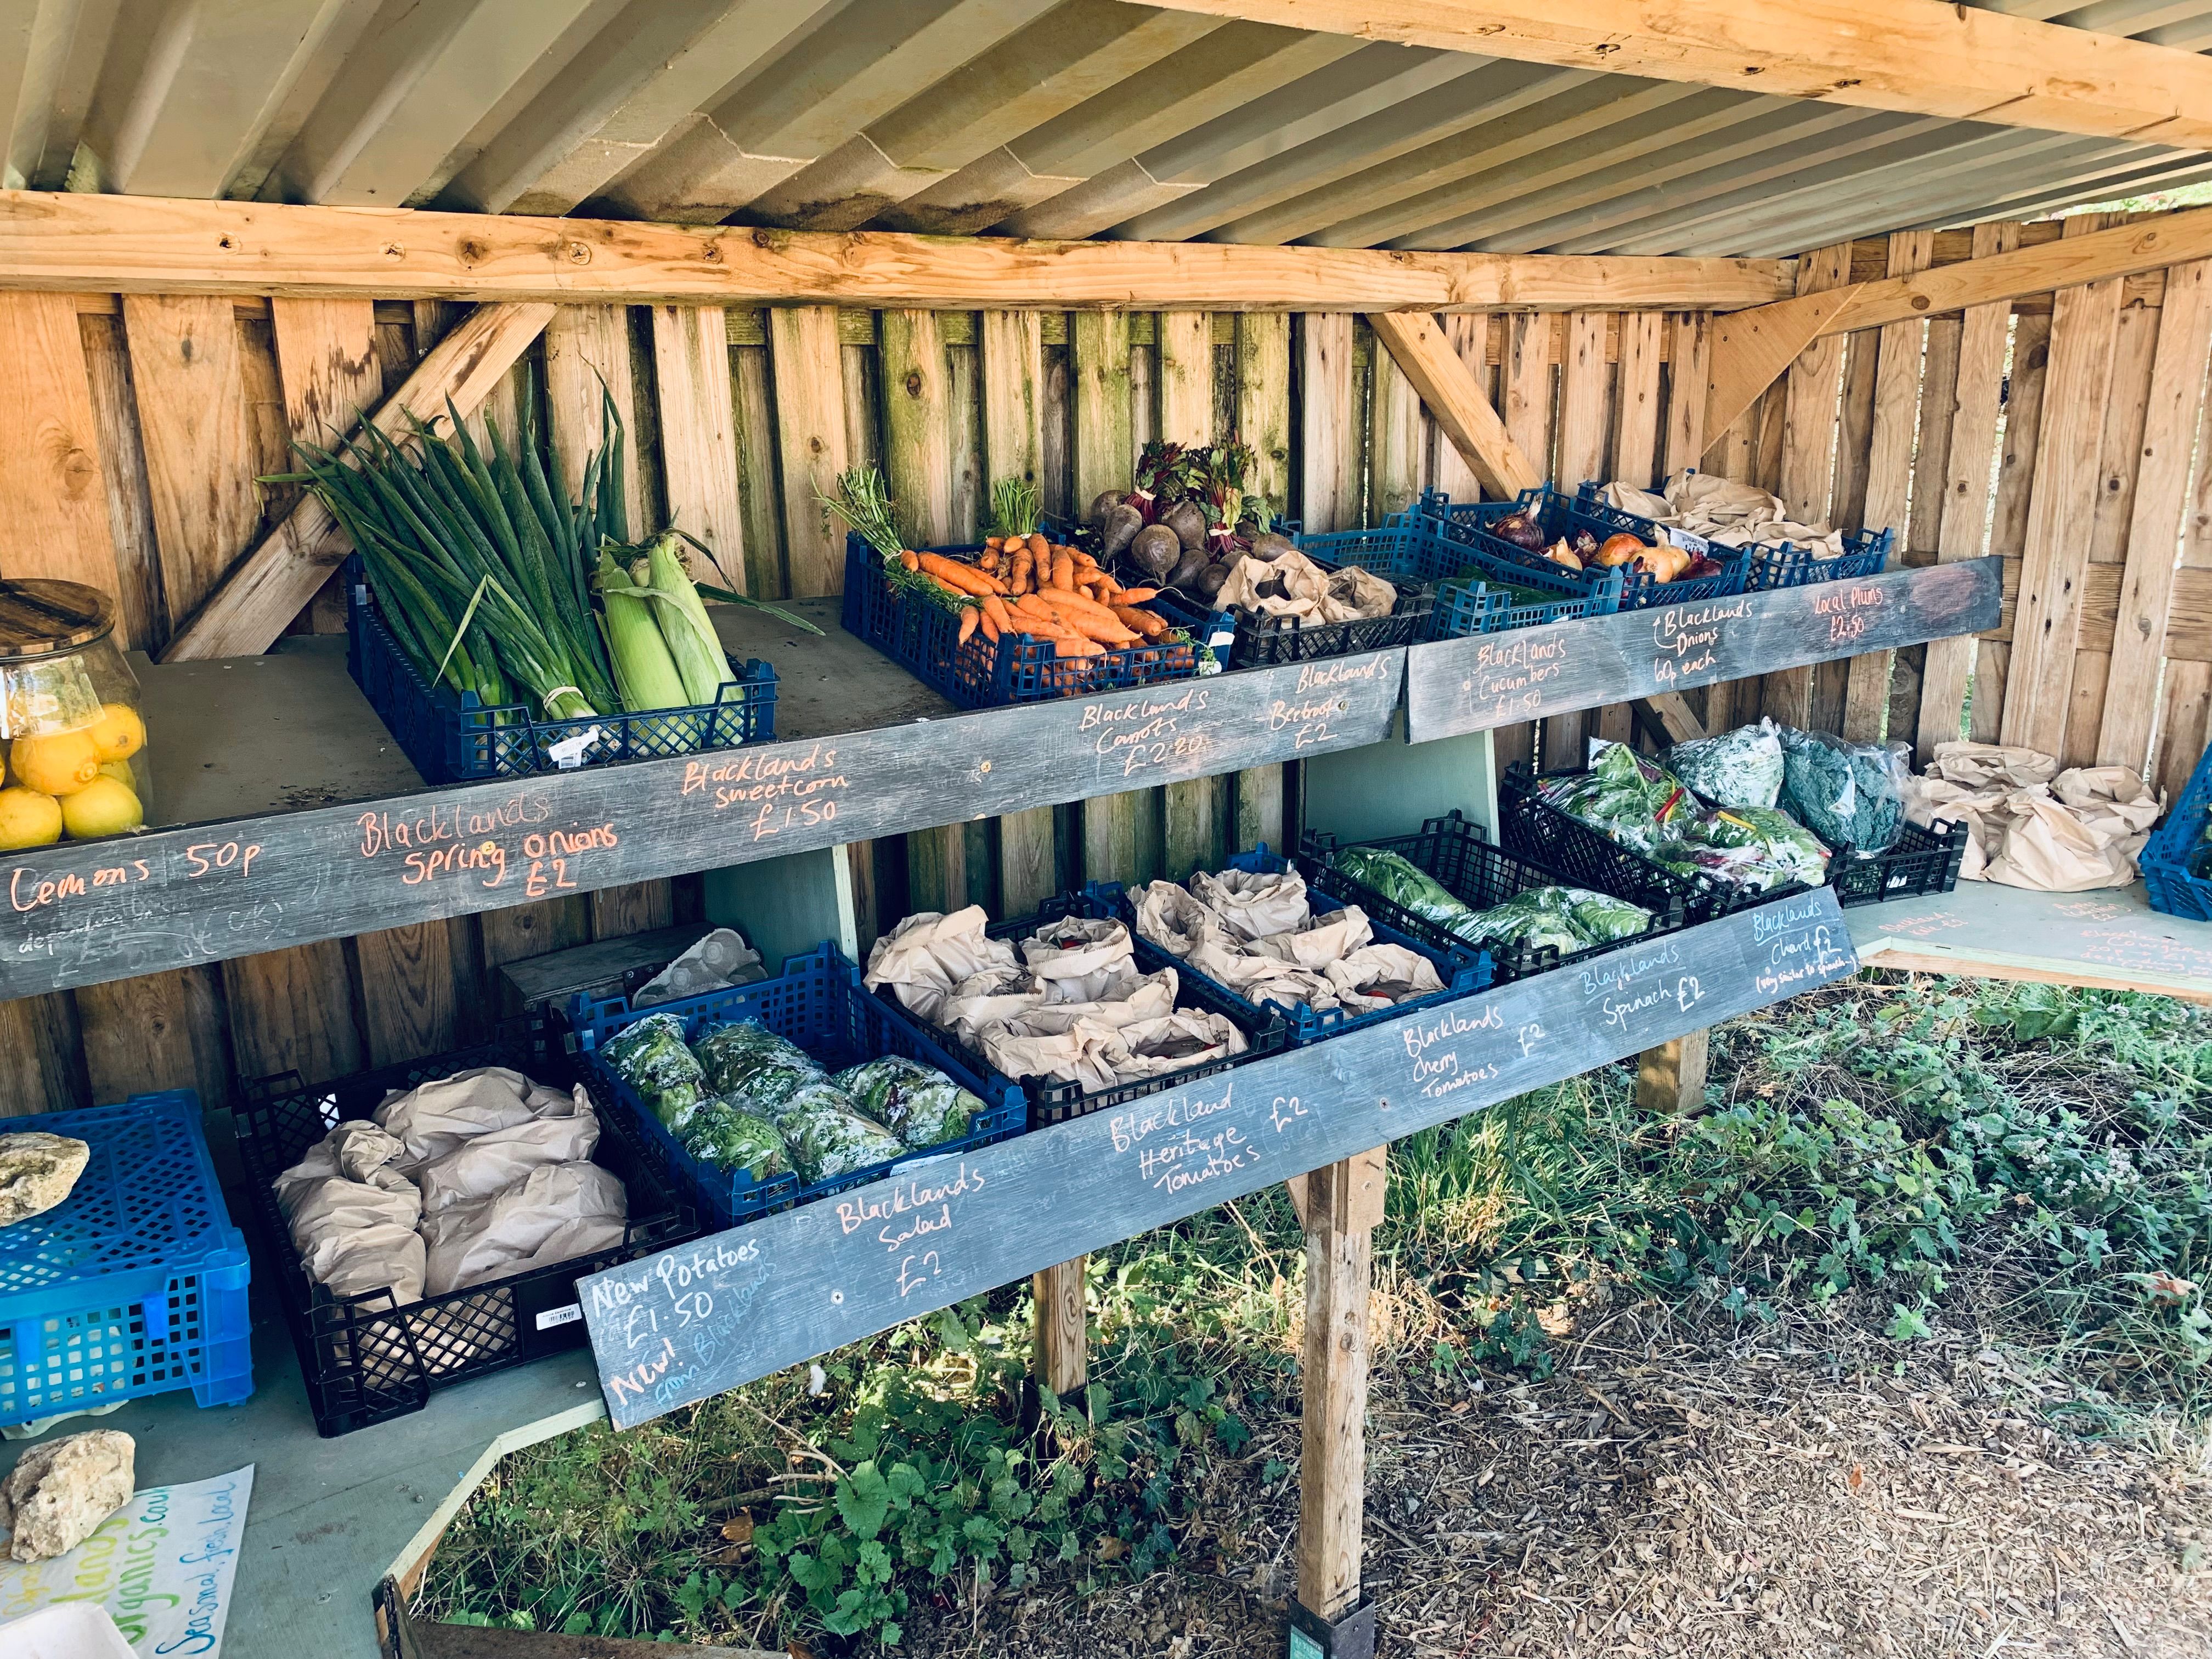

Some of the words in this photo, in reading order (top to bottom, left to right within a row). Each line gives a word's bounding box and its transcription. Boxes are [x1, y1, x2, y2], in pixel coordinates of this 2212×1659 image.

[1665, 600, 1752, 636] Blacklands
[1815, 588, 1847, 614] Local
[1852, 586, 1883, 608] Plums
[1472, 632, 1566, 674] Blacklands
[1677, 627, 1718, 657] Onions
[1295, 653, 1391, 694] Blacklands
[1480, 662, 1559, 700] Cucumbers
[1655, 658, 1677, 688] 60p
[1682, 649, 1716, 675] each
[1078, 689, 1209, 731] Blacklands
[1097, 717, 1177, 754] Carrots
[1295, 723, 1338, 749] £2
[681, 744, 837, 796] Blacklands
[358, 792, 550, 857] Blacklands
[749, 800, 836, 842] £1.50
[10, 859, 149, 911] Lemons
[187, 842, 261, 877] 50p
[525, 859, 577, 896] £2
[1753, 897, 1822, 941] Blacklands
[1771, 933, 1810, 965] Chard
[1813, 925, 1842, 965] £2
[1579, 939, 1679, 995] Blacklands
[1778, 968, 1804, 984] similar
[1804, 962, 1815, 975] to
[1602, 979, 1672, 1031] Spinach
[1677, 976, 1705, 1012] £2
[1403, 1005, 1504, 1058] Blacklands
[1517, 1023, 1546, 1058] £2
[1421, 1063, 1499, 1098] Tomatoes
[1110, 1082, 1233, 1152] Blackland
[1269, 1097, 1308, 1132] £2
[1139, 1126, 1248, 1180] Heritage
[1153, 1144, 1261, 1194] Tomatoes
[836, 1161, 985, 1234] Blacklands
[878, 1204, 952, 1252] Salad
[591, 1274, 648, 1317] New
[656, 1239, 760, 1300] Potatoes
[896, 1250, 942, 1297] £2
[624, 1291, 713, 1350] £1.50
